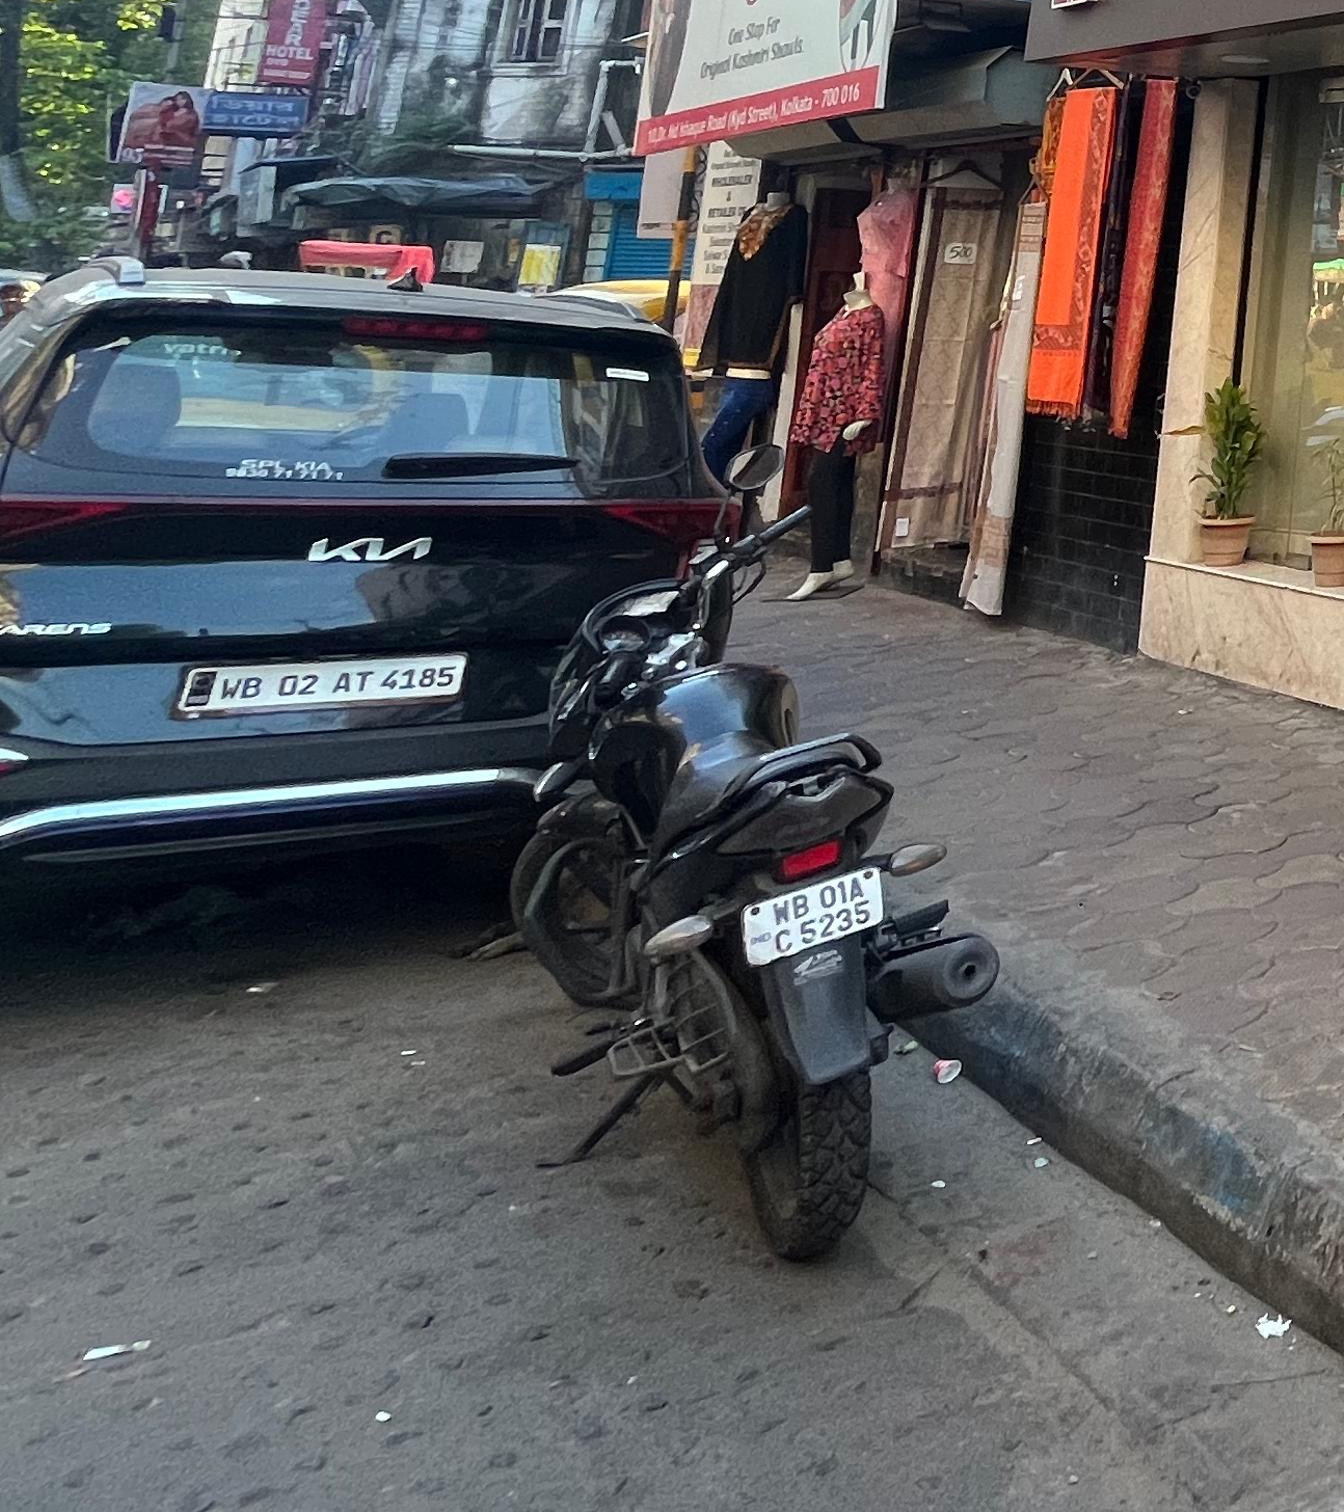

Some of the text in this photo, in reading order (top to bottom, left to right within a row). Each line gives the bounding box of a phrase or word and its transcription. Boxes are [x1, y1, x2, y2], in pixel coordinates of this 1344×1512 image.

[266, 45, 314, 60] HOTEL
[780, 96, 812, 116] Kolkata
[821, 86, 839, 108] 700
[840, 82, 860, 105] 016
[307, 537, 433, 563] KIA
[221, 666, 457, 699] WB 02 AT 4185
[773, 877, 865, 926] WB 01A
[775, 900, 871, 954] C 5235
